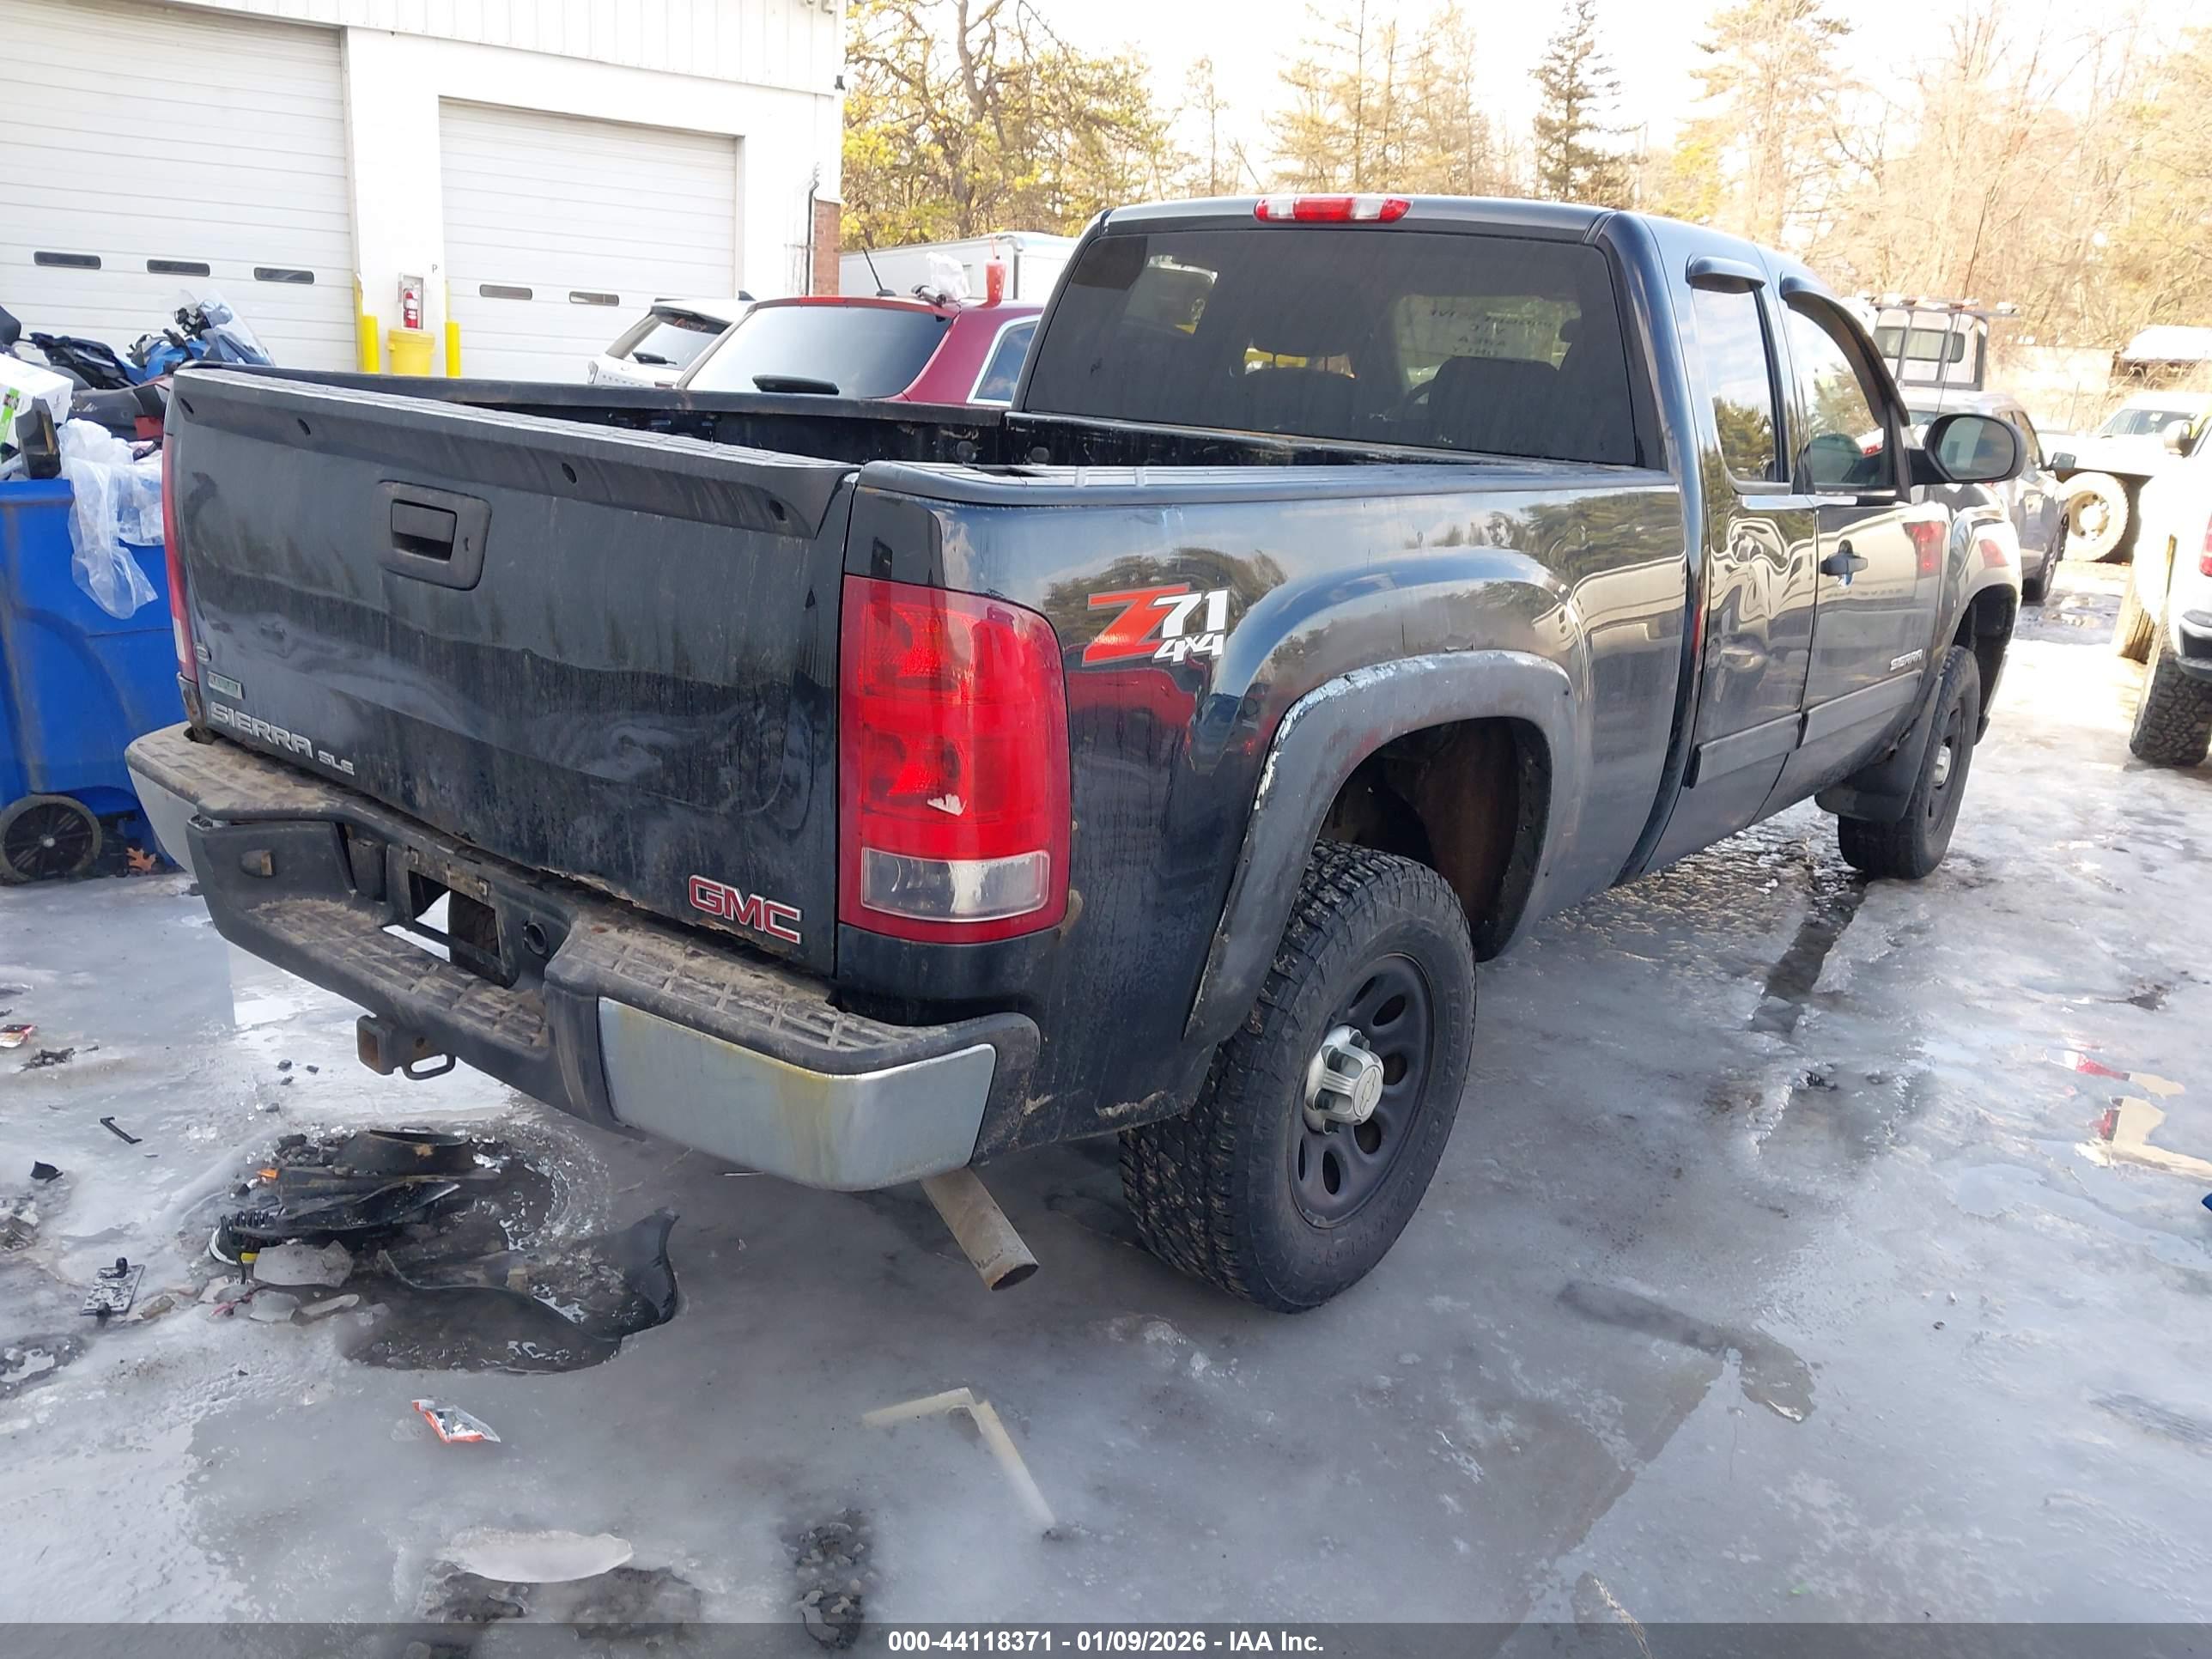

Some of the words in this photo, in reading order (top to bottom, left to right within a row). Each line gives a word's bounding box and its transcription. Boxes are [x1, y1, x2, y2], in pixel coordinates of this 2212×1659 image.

[1082, 582, 1230, 666] Z71
[210, 702, 313, 758] SIERRA
[318, 750, 355, 775] SLE
[689, 874, 803, 945] GMC
